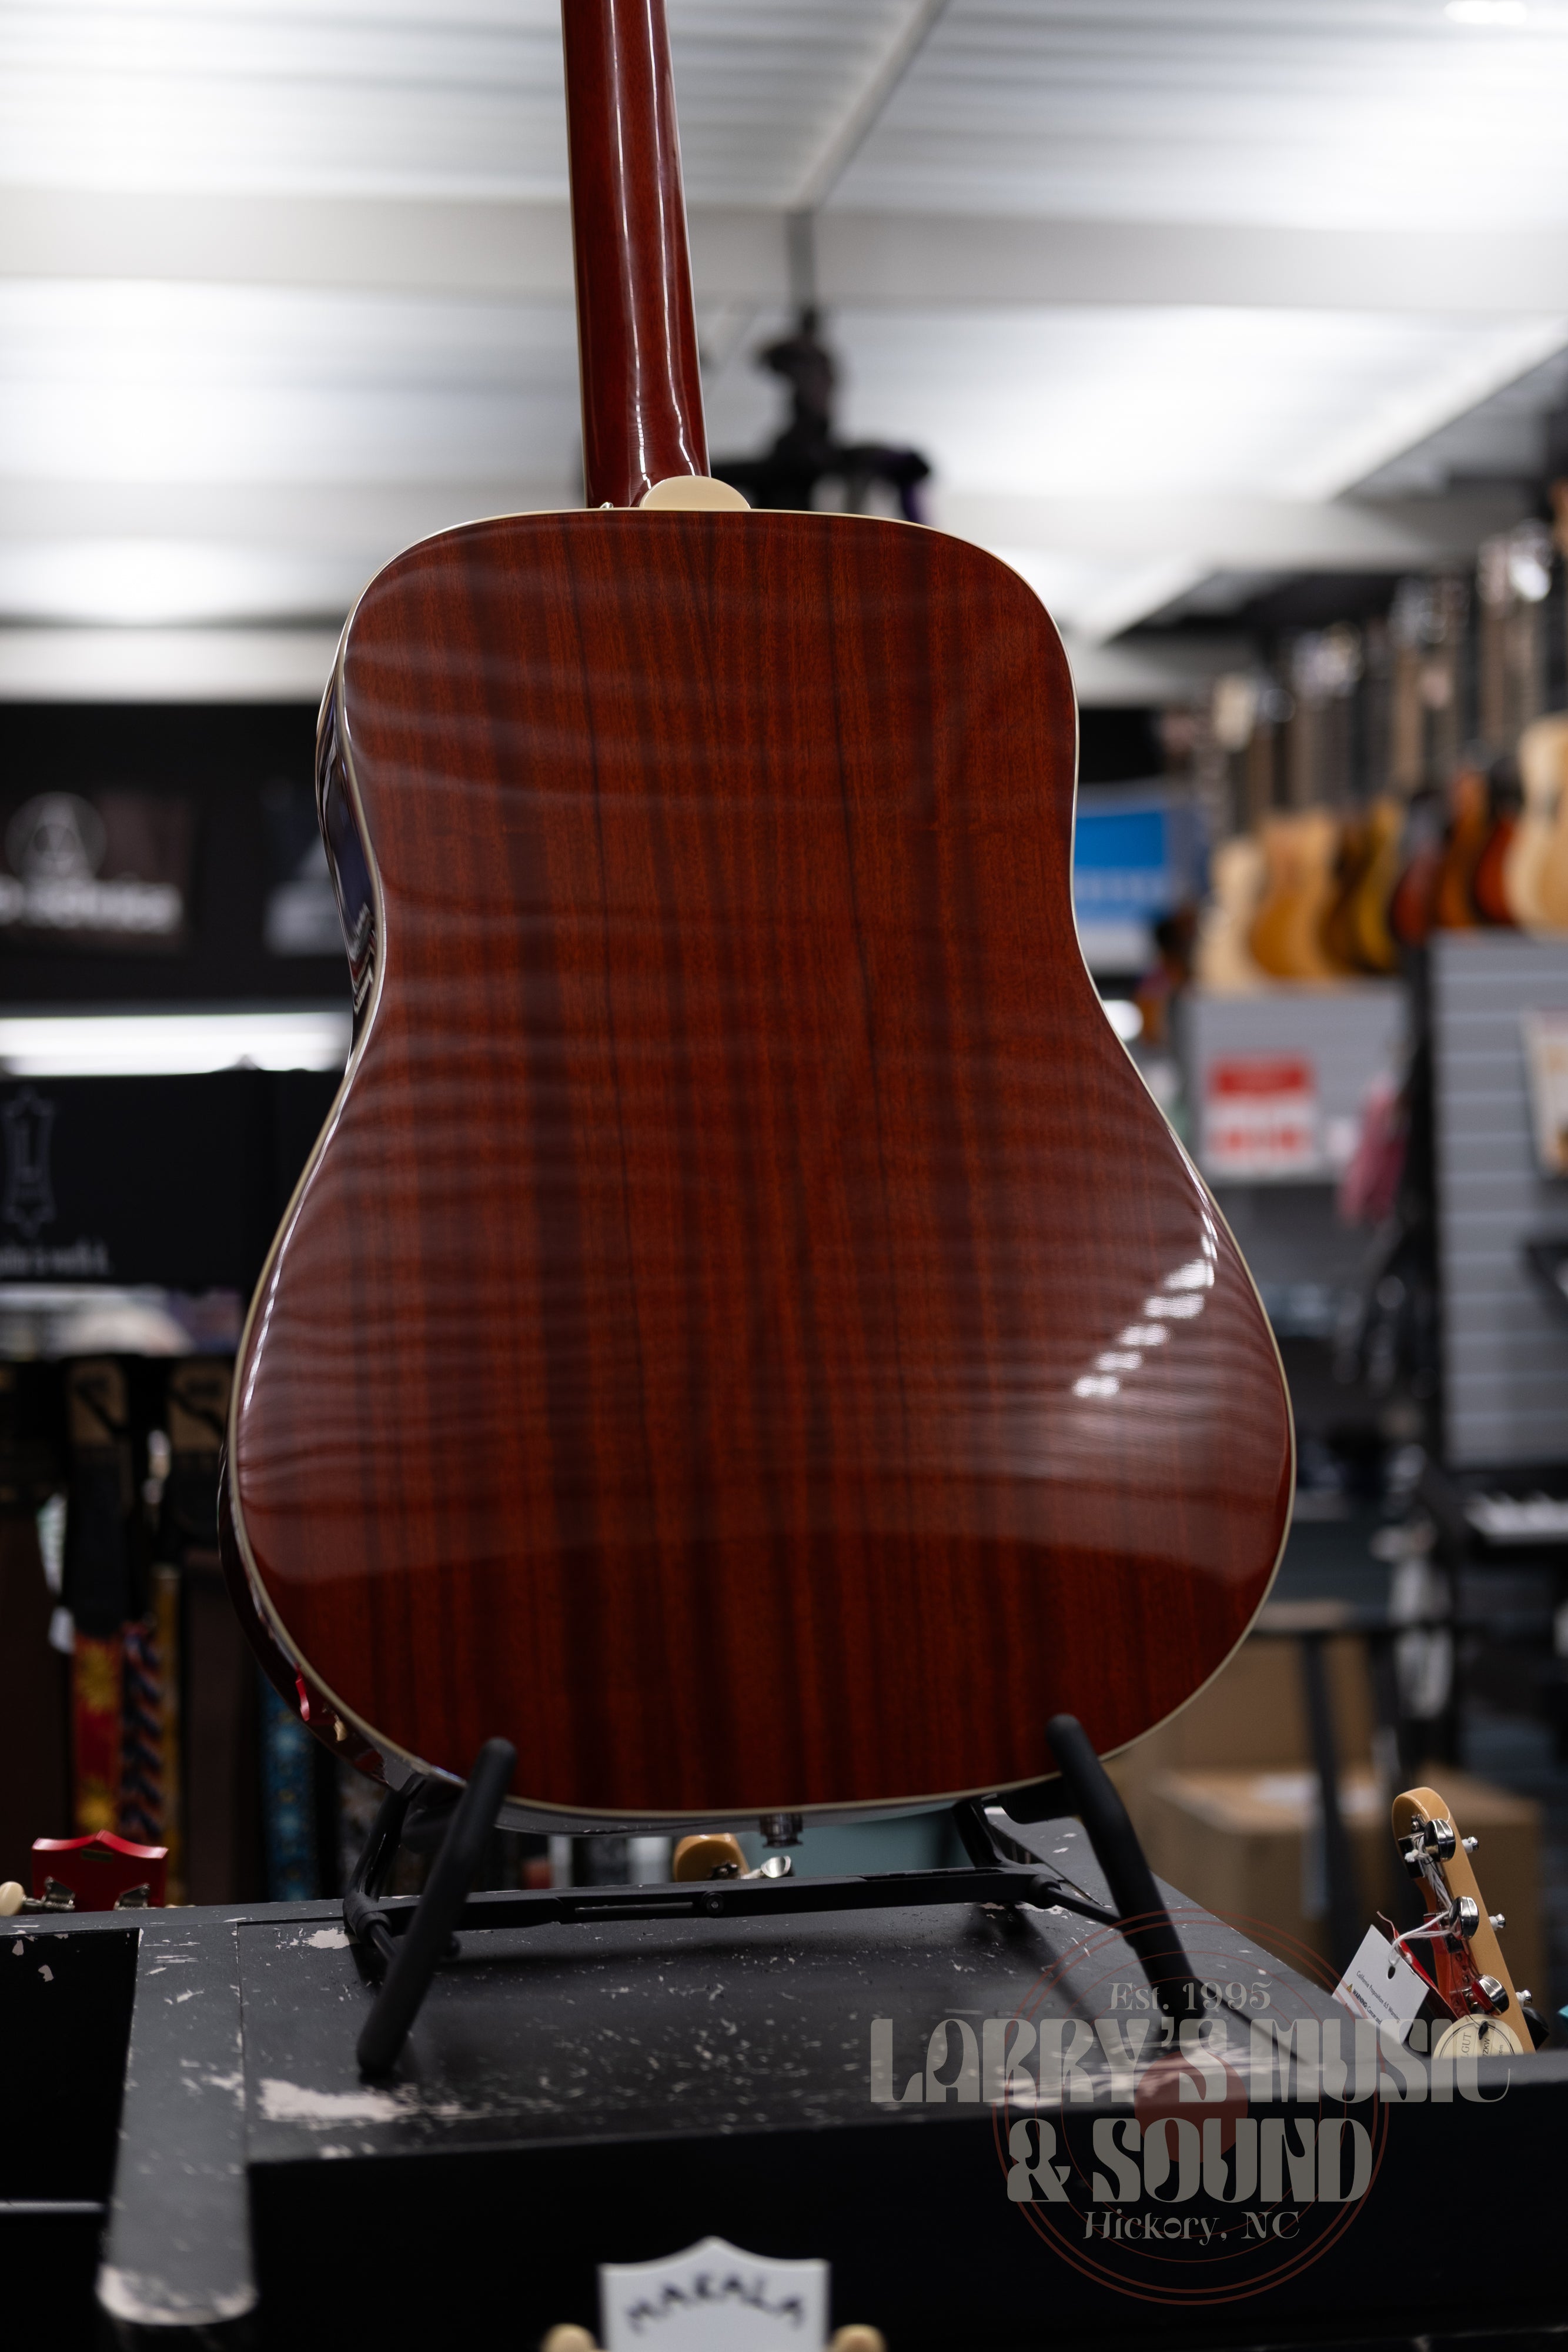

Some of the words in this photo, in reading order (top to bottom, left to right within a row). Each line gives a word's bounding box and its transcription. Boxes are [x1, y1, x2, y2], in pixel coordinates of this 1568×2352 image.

[1356, 1970, 1369, 1988] California
[1369, 1984, 1384, 2004] Proposition
[1352, 1989, 1368, 2010] WARNING:
[1367, 2006, 1377, 2022] Cancer
